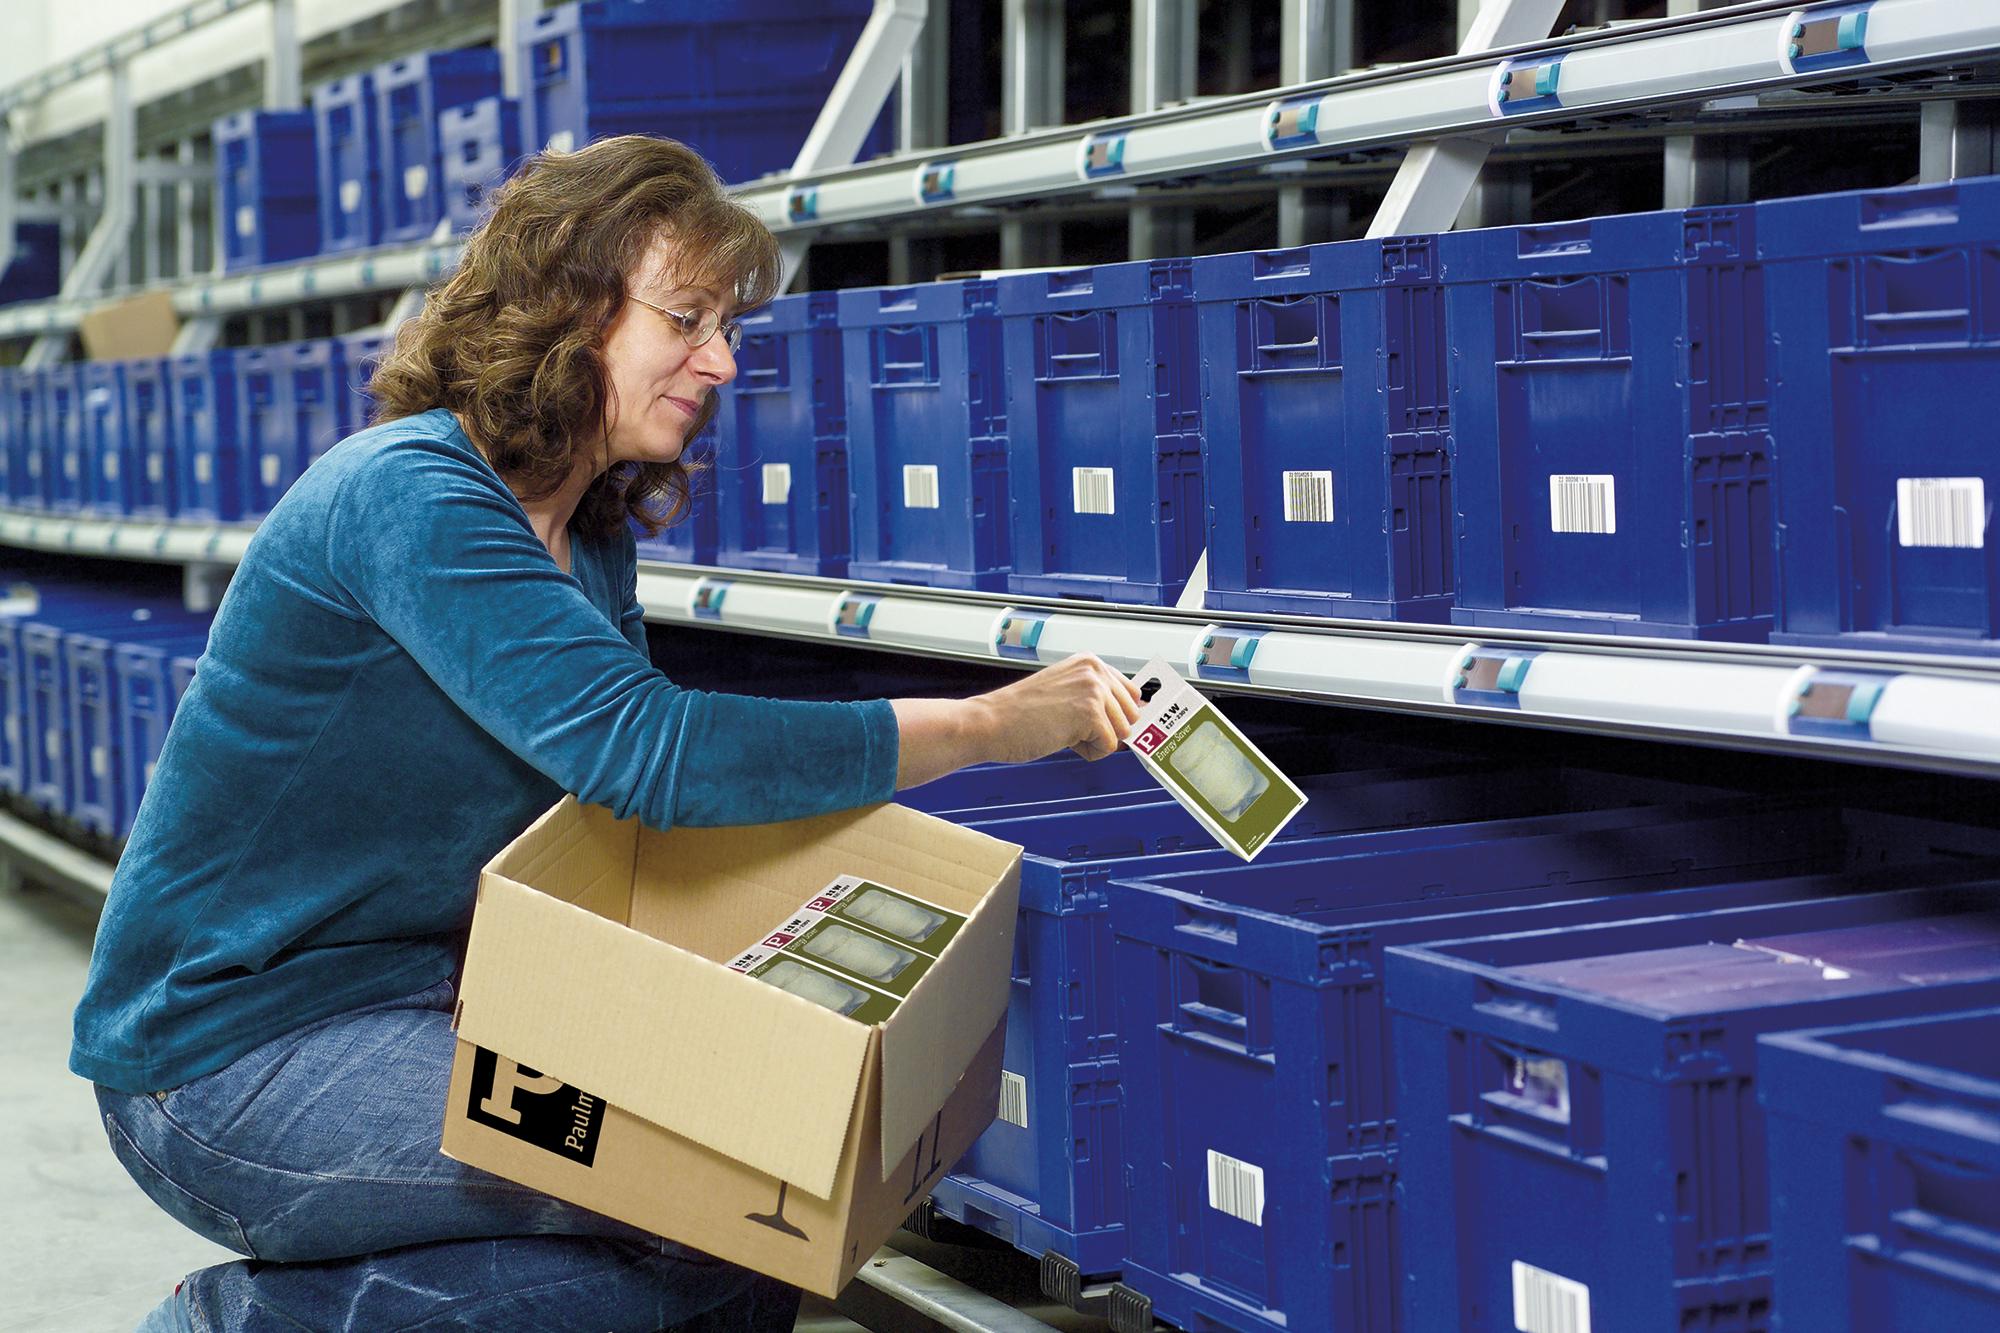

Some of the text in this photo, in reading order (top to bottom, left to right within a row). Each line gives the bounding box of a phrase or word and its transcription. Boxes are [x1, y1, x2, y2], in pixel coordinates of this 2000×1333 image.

[1159, 703, 1180, 725] 11 W
[1136, 732, 1155, 752] P
[1155, 739, 1177, 762] Energy
[1175, 724, 1192, 743] Saver
[808, 900, 826, 909] P
[764, 937, 784, 948] P
[734, 953, 754, 967] 11 W
